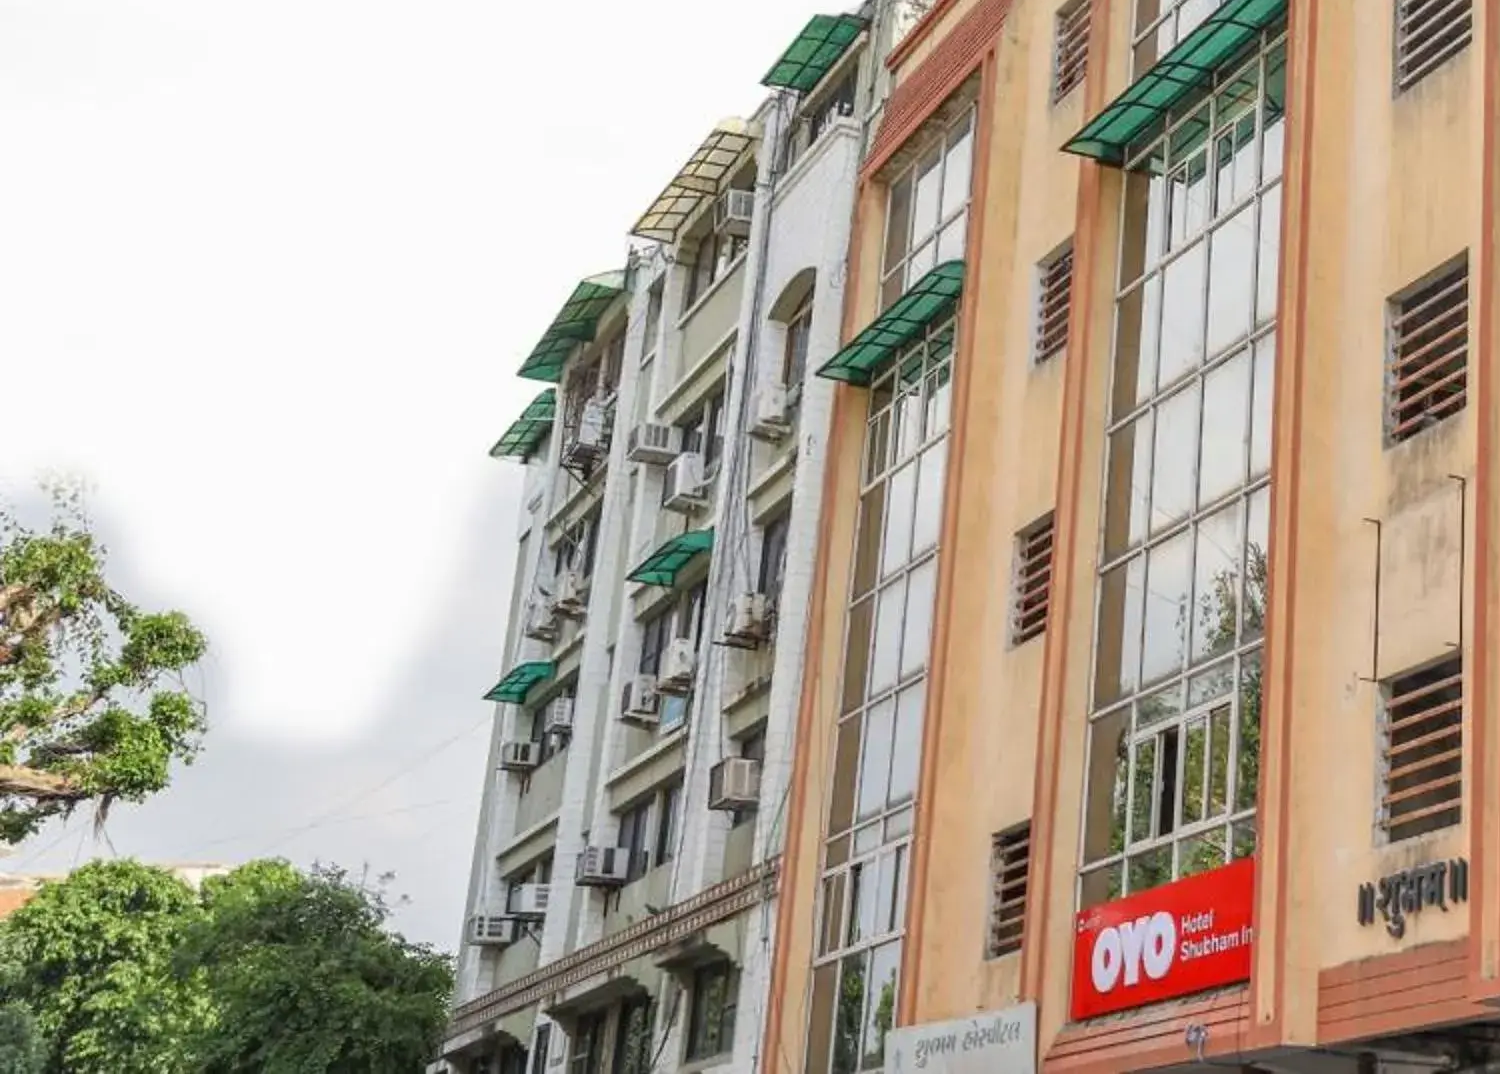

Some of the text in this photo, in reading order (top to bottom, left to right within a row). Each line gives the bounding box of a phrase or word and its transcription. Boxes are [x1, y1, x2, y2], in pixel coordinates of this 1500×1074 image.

[1181, 909, 1214, 935] Hotel
[1092, 911, 1176, 993] OYO
[1180, 931, 1239, 962] Shubham
